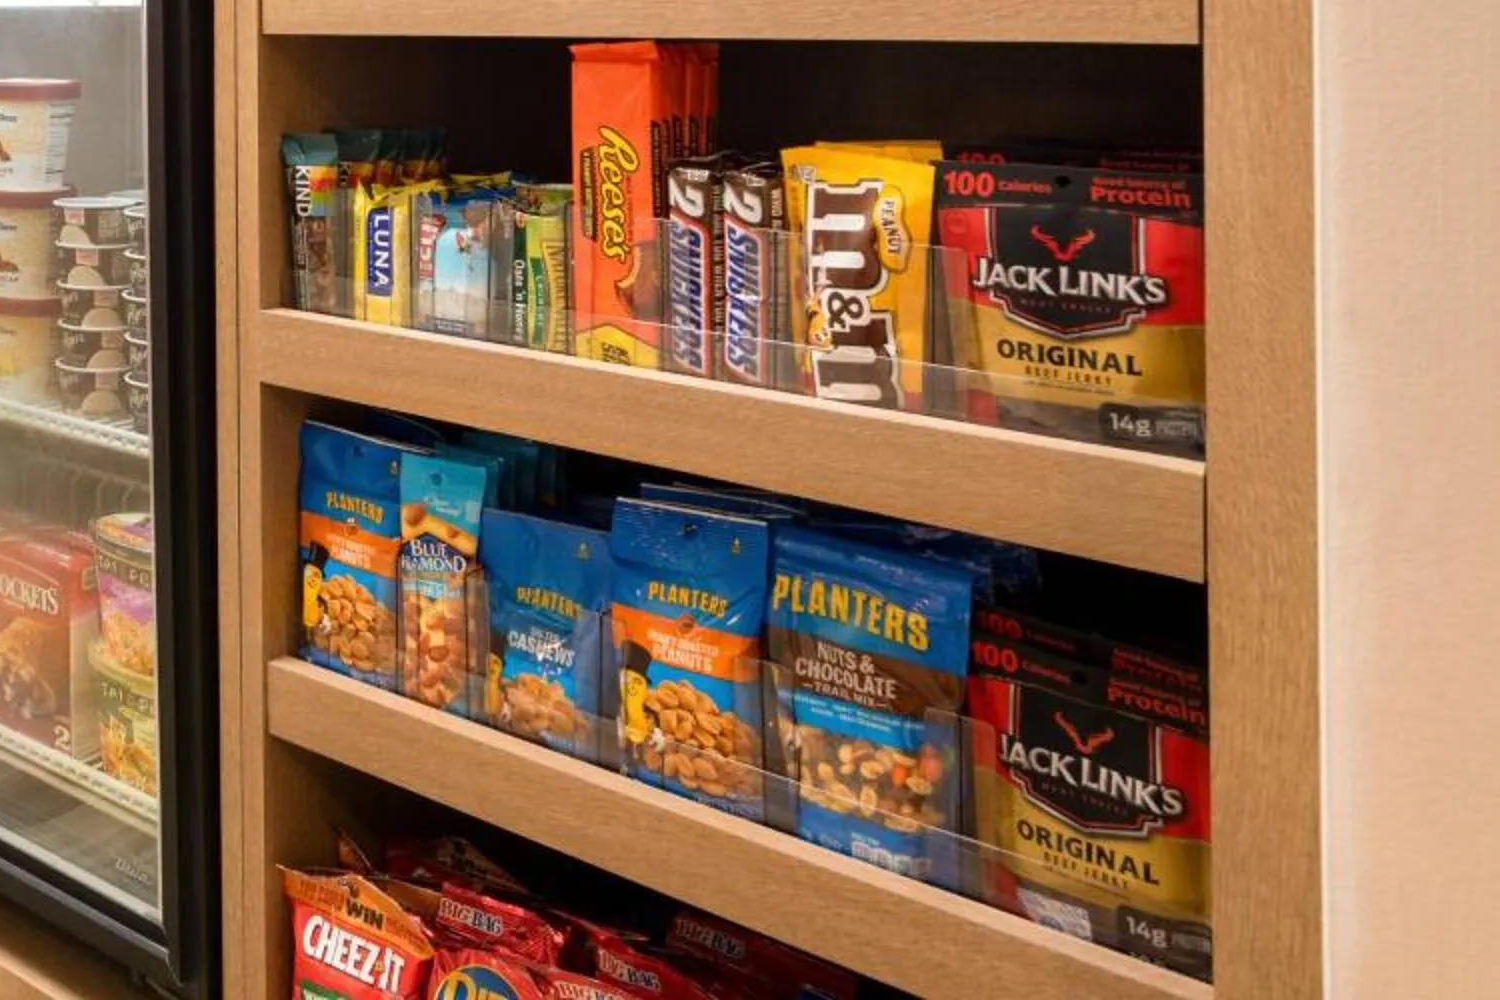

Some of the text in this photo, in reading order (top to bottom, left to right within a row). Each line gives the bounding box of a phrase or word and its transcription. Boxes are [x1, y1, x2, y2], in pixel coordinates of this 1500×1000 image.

[294, 165, 313, 217] KIND
[598, 125, 640, 264] Reese's
[668, 175, 704, 218] 2
[723, 178, 763, 225] 2
[944, 169, 995, 198] 100
[1091, 184, 1192, 209] Protein
[882, 198, 901, 256] PEANUT
[372, 213, 391, 288] LUNA
[670, 219, 702, 370] SNICKERS
[973, 257, 1057, 297] JACK
[726, 223, 758, 376] SNICKERS
[996, 338, 1143, 377] ORIGINAL
[1108, 411, 1153, 438] 14g
[325, 490, 385, 525] PLANTERS
[411, 538, 448, 558] BLUE
[647, 580, 728, 618] PLANTERS
[772, 573, 930, 652] PLANTERS
[817, 641, 875, 675] NUTS &
[972, 640, 1019, 674] 100
[795, 656, 898, 700] CHOCOLATE
[1107, 685, 1206, 725] Protein
[53, 724, 71, 750] 2
[1000, 732, 1078, 785] JACK
[1016, 818, 1161, 886] ORIGINAL
[345, 898, 385, 931] WIN
[438, 896, 502, 936] BIG BAG
